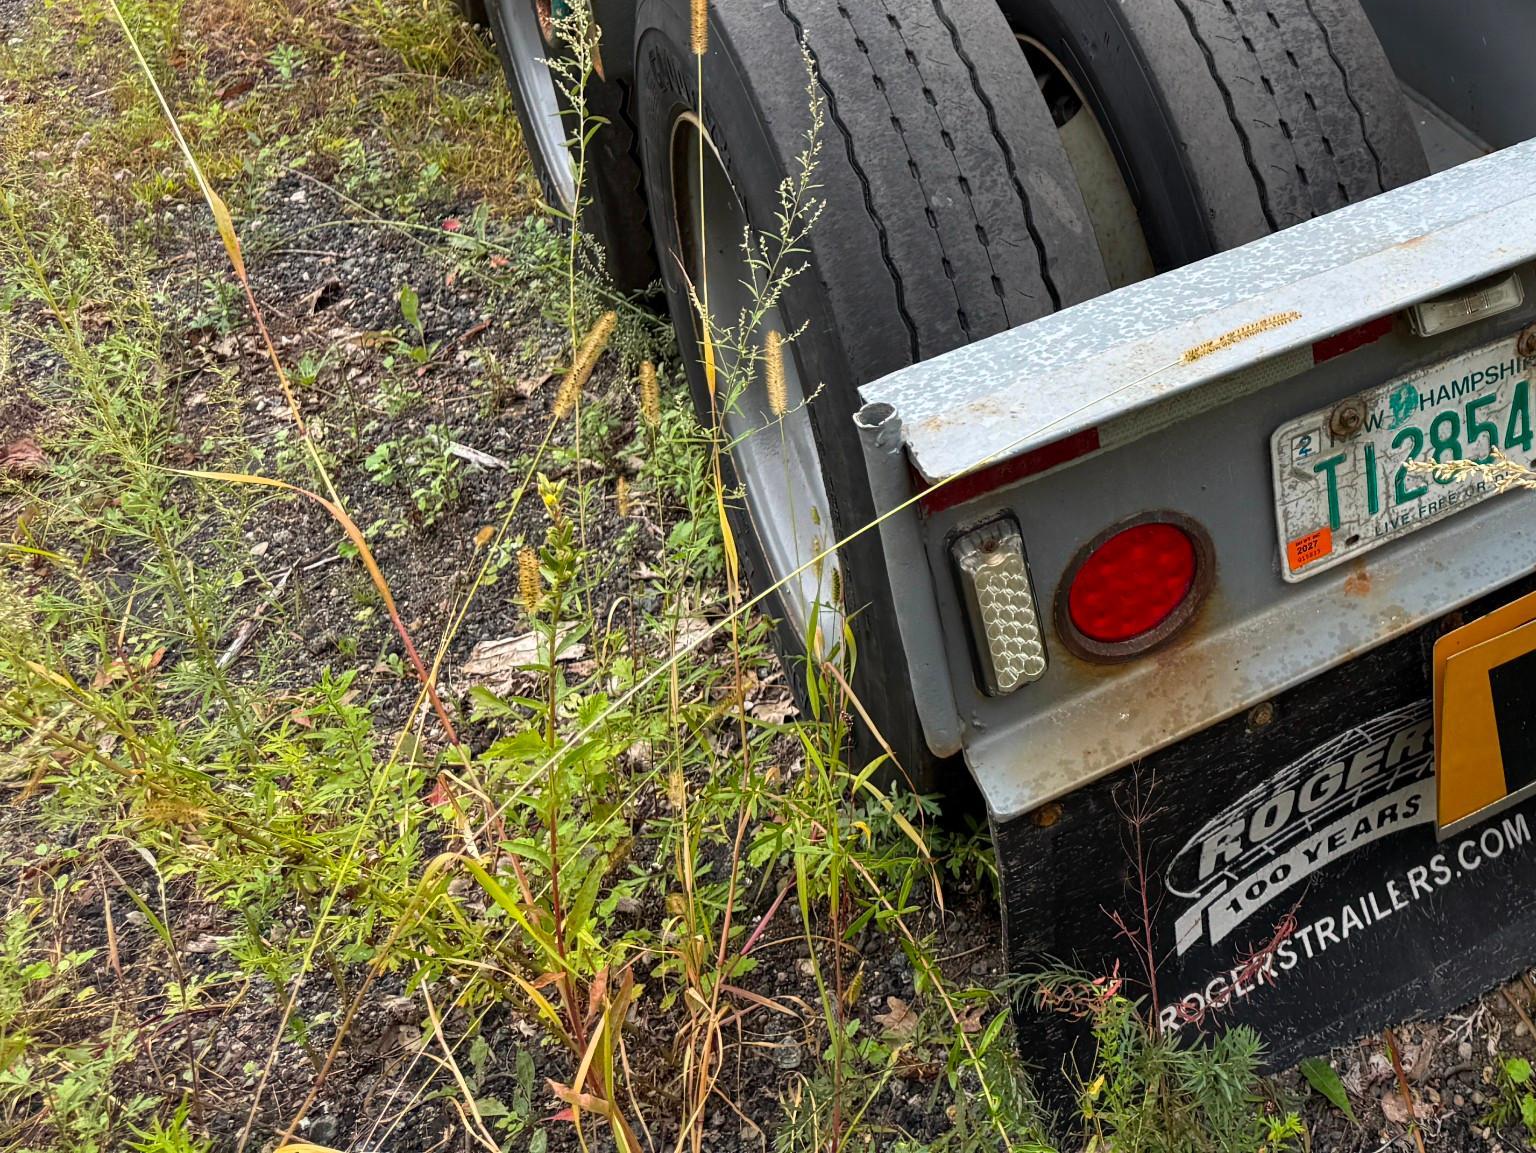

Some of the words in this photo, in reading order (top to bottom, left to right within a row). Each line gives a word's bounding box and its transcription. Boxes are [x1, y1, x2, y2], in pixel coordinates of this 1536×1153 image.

[1296, 539, 1319, 556] 2027
[1374, 513, 1411, 537] LIVE
[1198, 718, 1435, 881] ROGER
[1226, 864, 1292, 915] 100
[1302, 794, 1422, 865] YEARS
